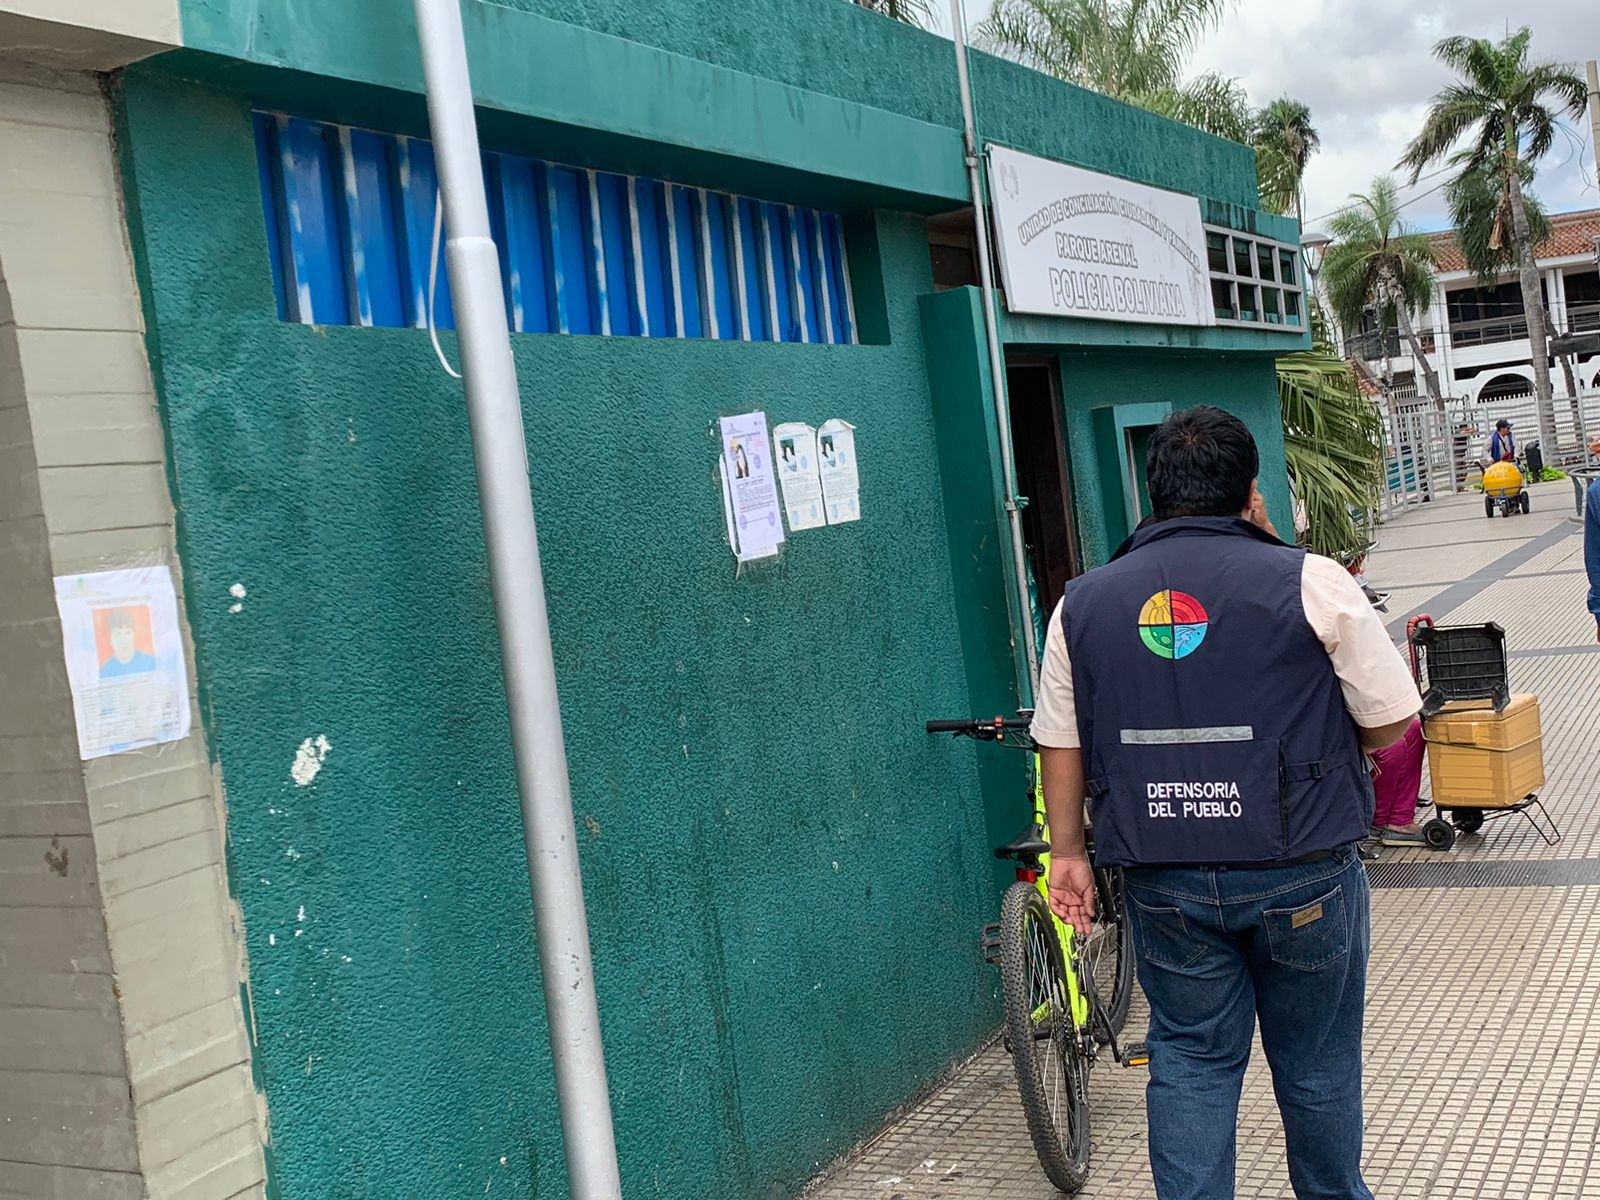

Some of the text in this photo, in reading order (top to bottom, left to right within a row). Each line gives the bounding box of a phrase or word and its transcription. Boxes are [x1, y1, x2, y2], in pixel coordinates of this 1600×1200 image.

[1018, 206, 1051, 246] UNIDAD
[1049, 200, 1064, 224] DE
[1062, 191, 1119, 219] CONCILIACIÓN
[1119, 198, 1162, 237] CIUDADANA
[1055, 231, 1138, 269] PARQUE ARENAL
[1049, 267, 1186, 317] POLICIA BOLIVIANA
[1147, 782, 1240, 799] DEFENSORIA
[1148, 801, 1242, 818] DEL PUEBLO
